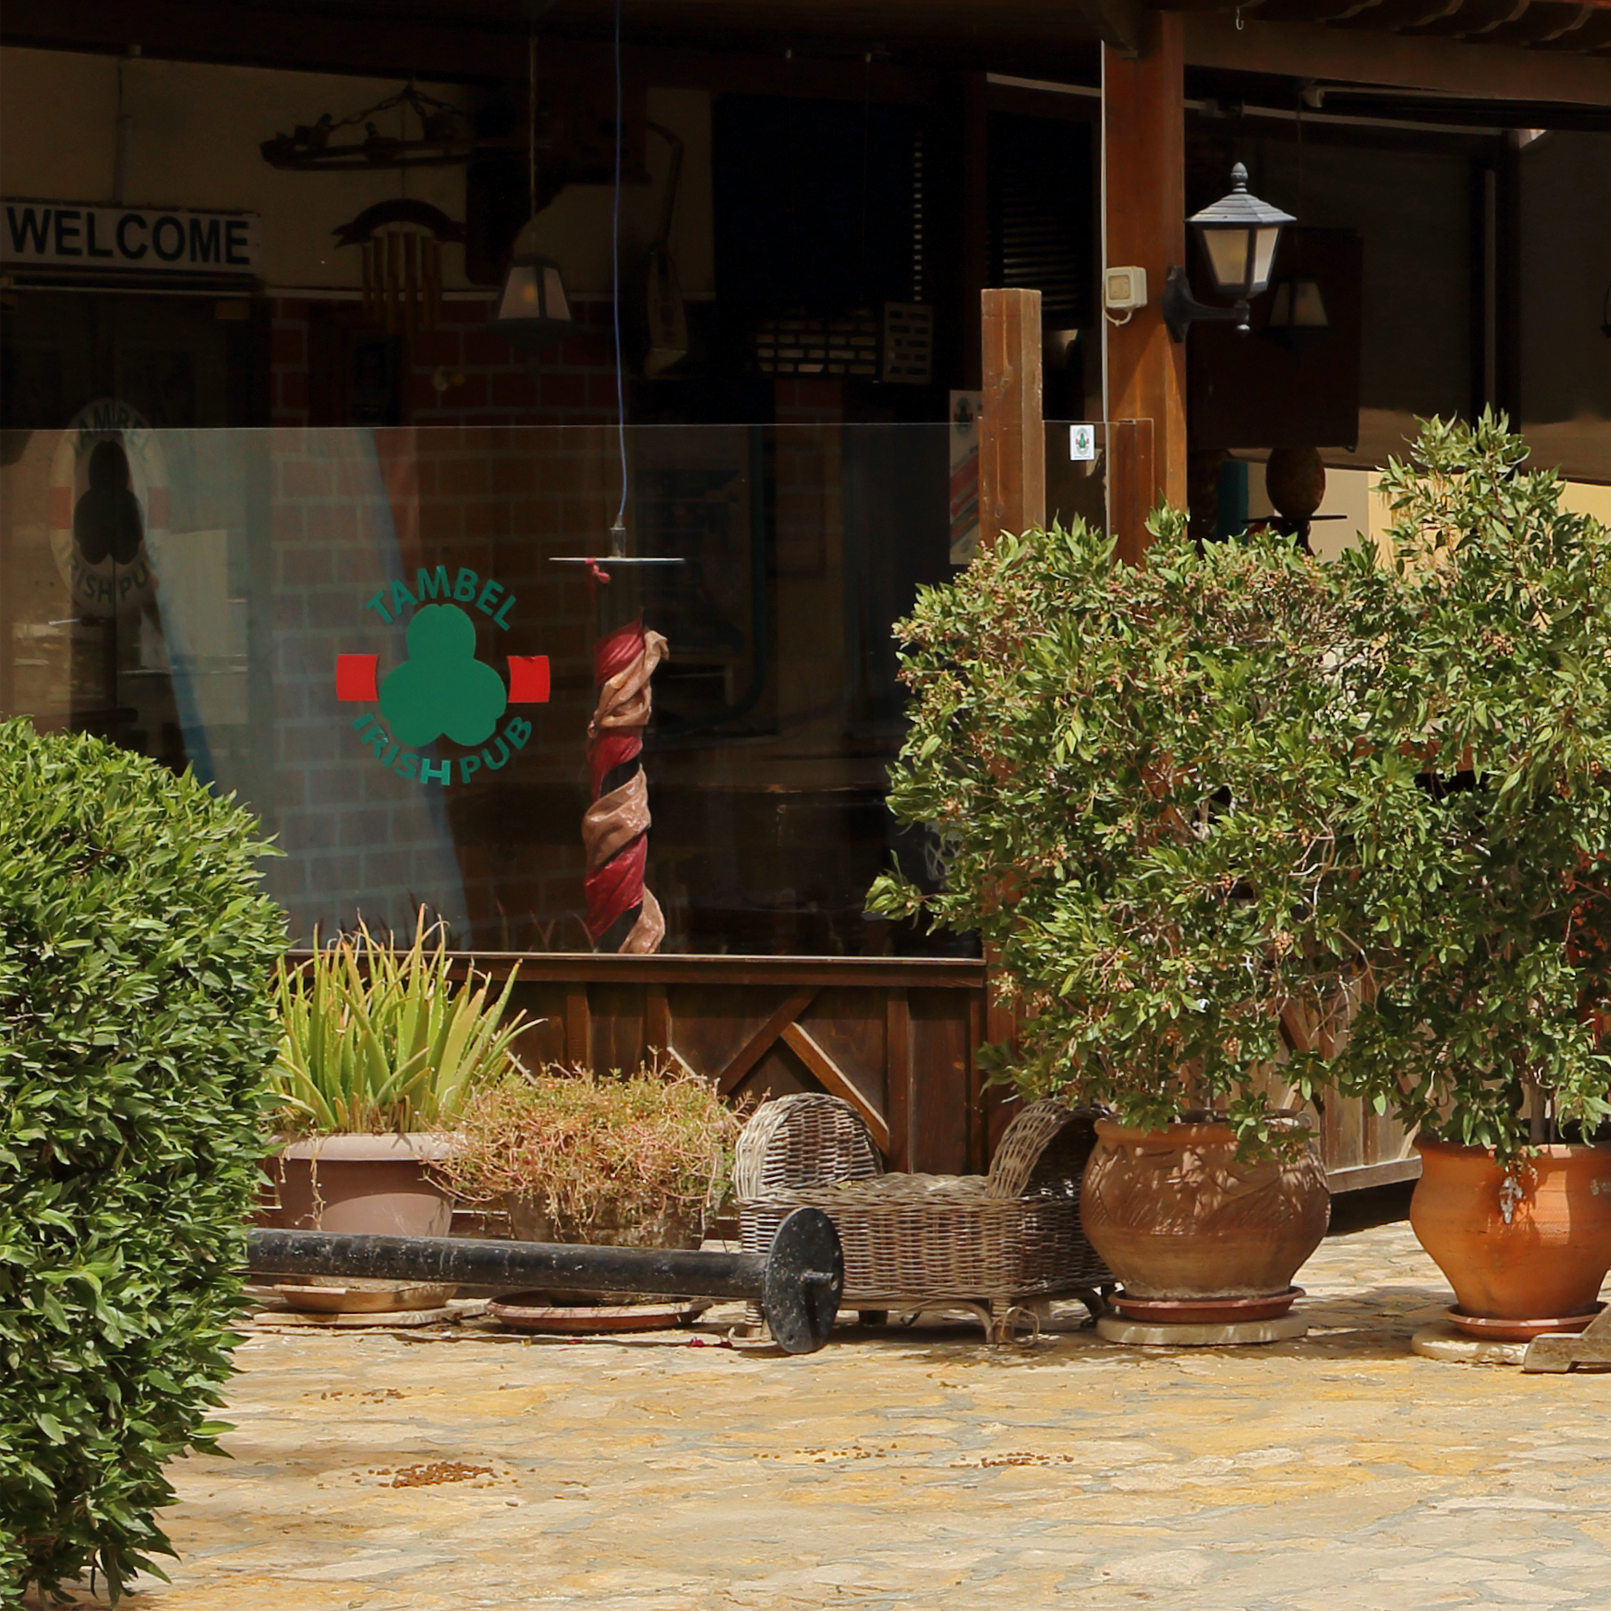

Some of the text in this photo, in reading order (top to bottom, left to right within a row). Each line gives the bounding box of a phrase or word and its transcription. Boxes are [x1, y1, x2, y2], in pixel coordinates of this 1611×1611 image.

[5, 205, 251, 266] WELCOME
[366, 565, 520, 631] TAMBEL
[352, 712, 534, 786] IRISH PUB
